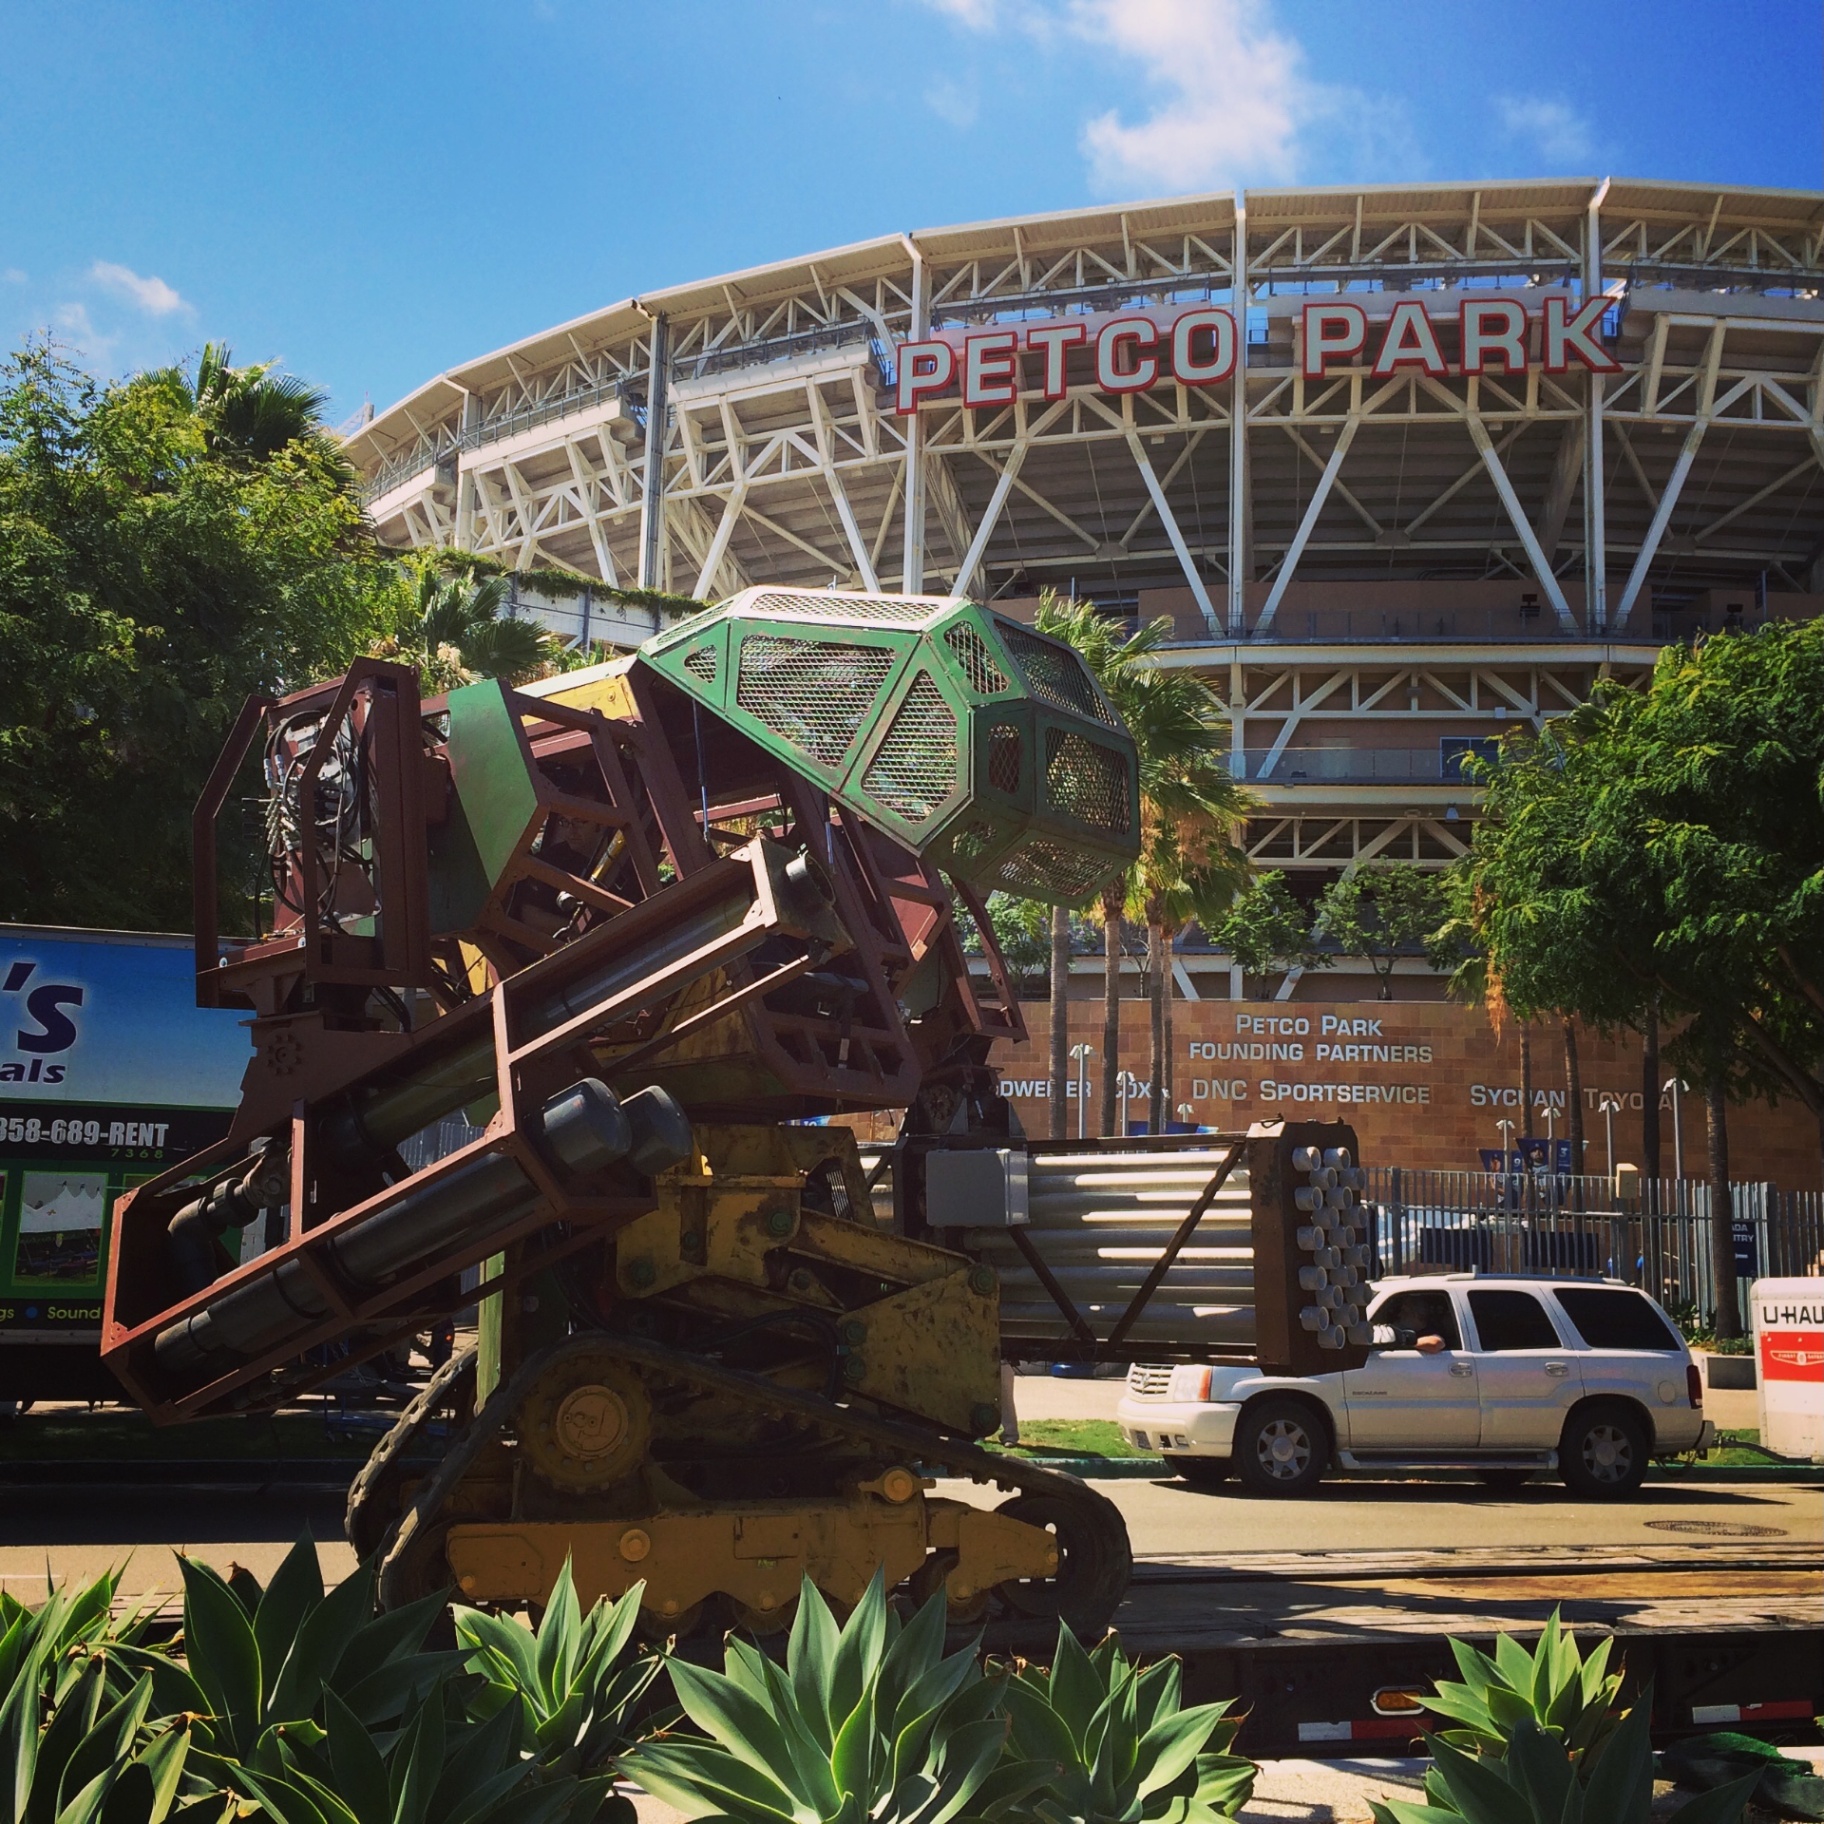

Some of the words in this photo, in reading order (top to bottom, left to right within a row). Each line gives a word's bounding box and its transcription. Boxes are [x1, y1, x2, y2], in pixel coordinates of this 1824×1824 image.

[896, 308, 1238, 415] PETCO
[1302, 296, 1624, 380] PARK
[1236, 1014, 1310, 1035] PETCO
[1321, 1015, 1384, 1037] PARK
[1189, 1043, 1304, 1061] FOUNDING
[1316, 1044, 1433, 1064] PARTNERS
[1192, 1079, 1247, 1100] DNC
[1260, 1080, 1430, 1104] SPORTSERVICE
[1583, 1088, 1673, 1111] TOYOA
[1733, 1234, 1754, 1242] TRY
[47, 1306, 101, 1319] Sound
